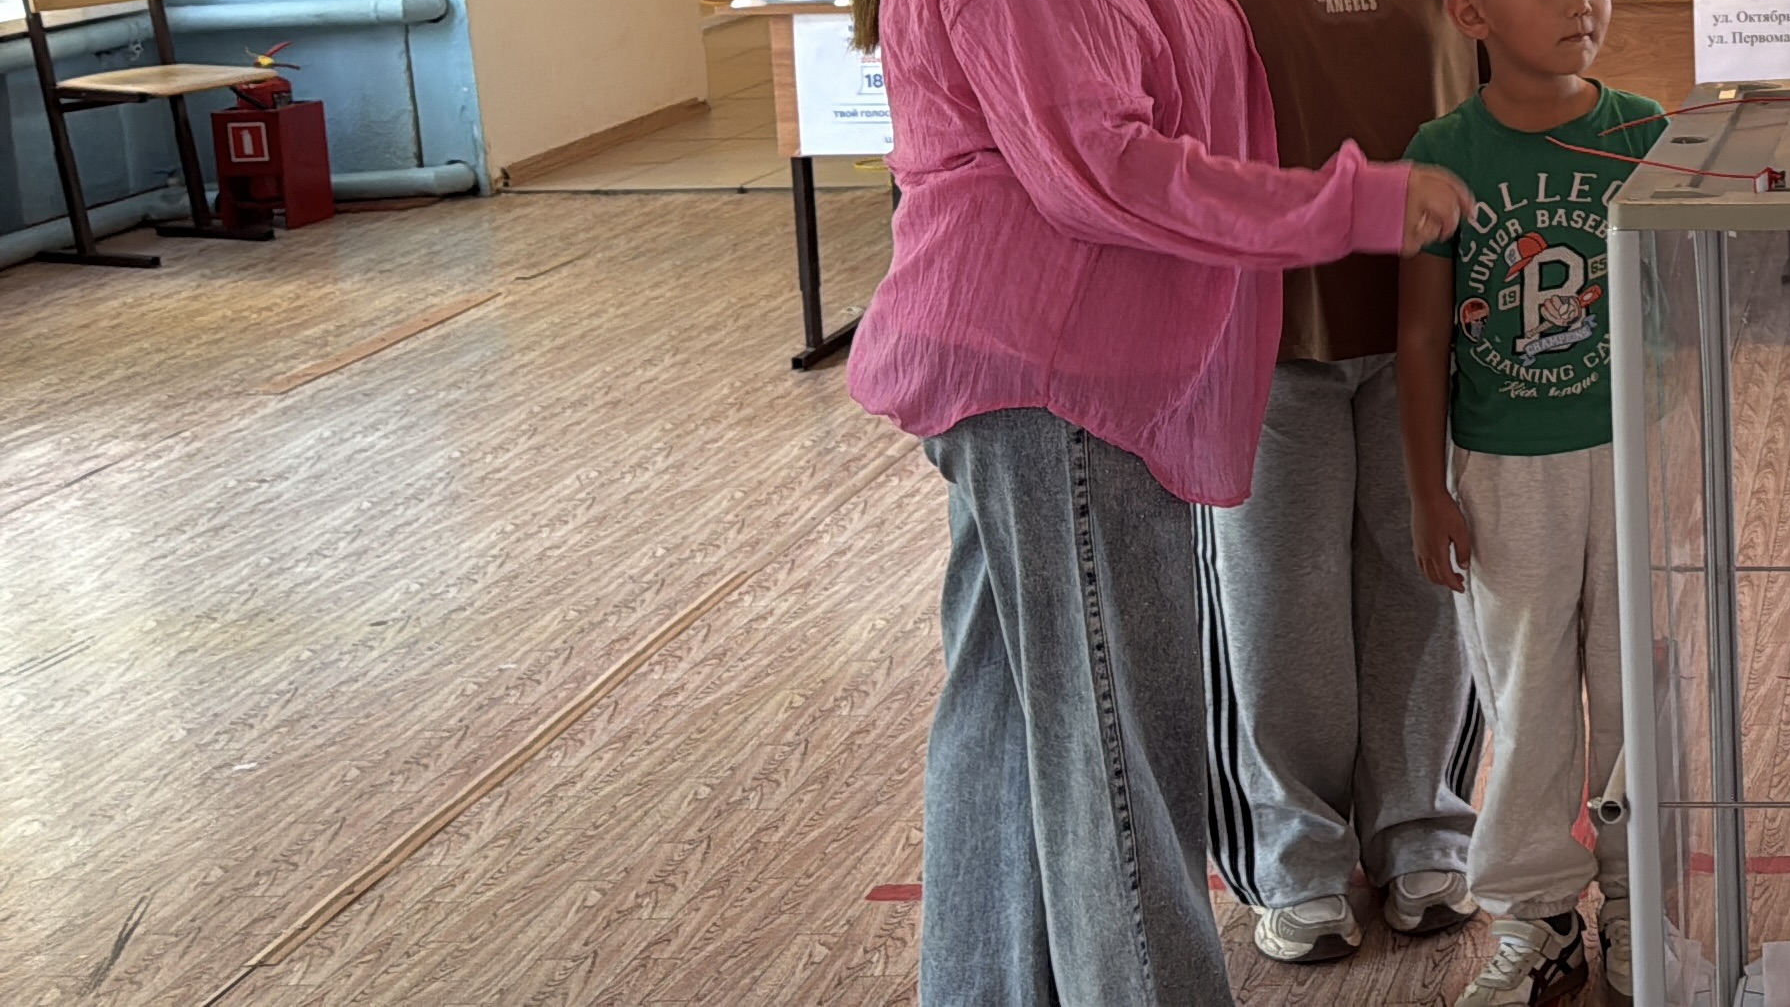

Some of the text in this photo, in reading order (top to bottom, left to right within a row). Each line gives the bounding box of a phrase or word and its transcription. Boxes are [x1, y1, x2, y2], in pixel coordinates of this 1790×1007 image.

[1712, 12, 1733, 27] ул.
[1707, 33, 1728, 48] ул.
[1468, 218, 1523, 294] JUNIOR
[1476, 333, 1611, 384] TRAINING CA
